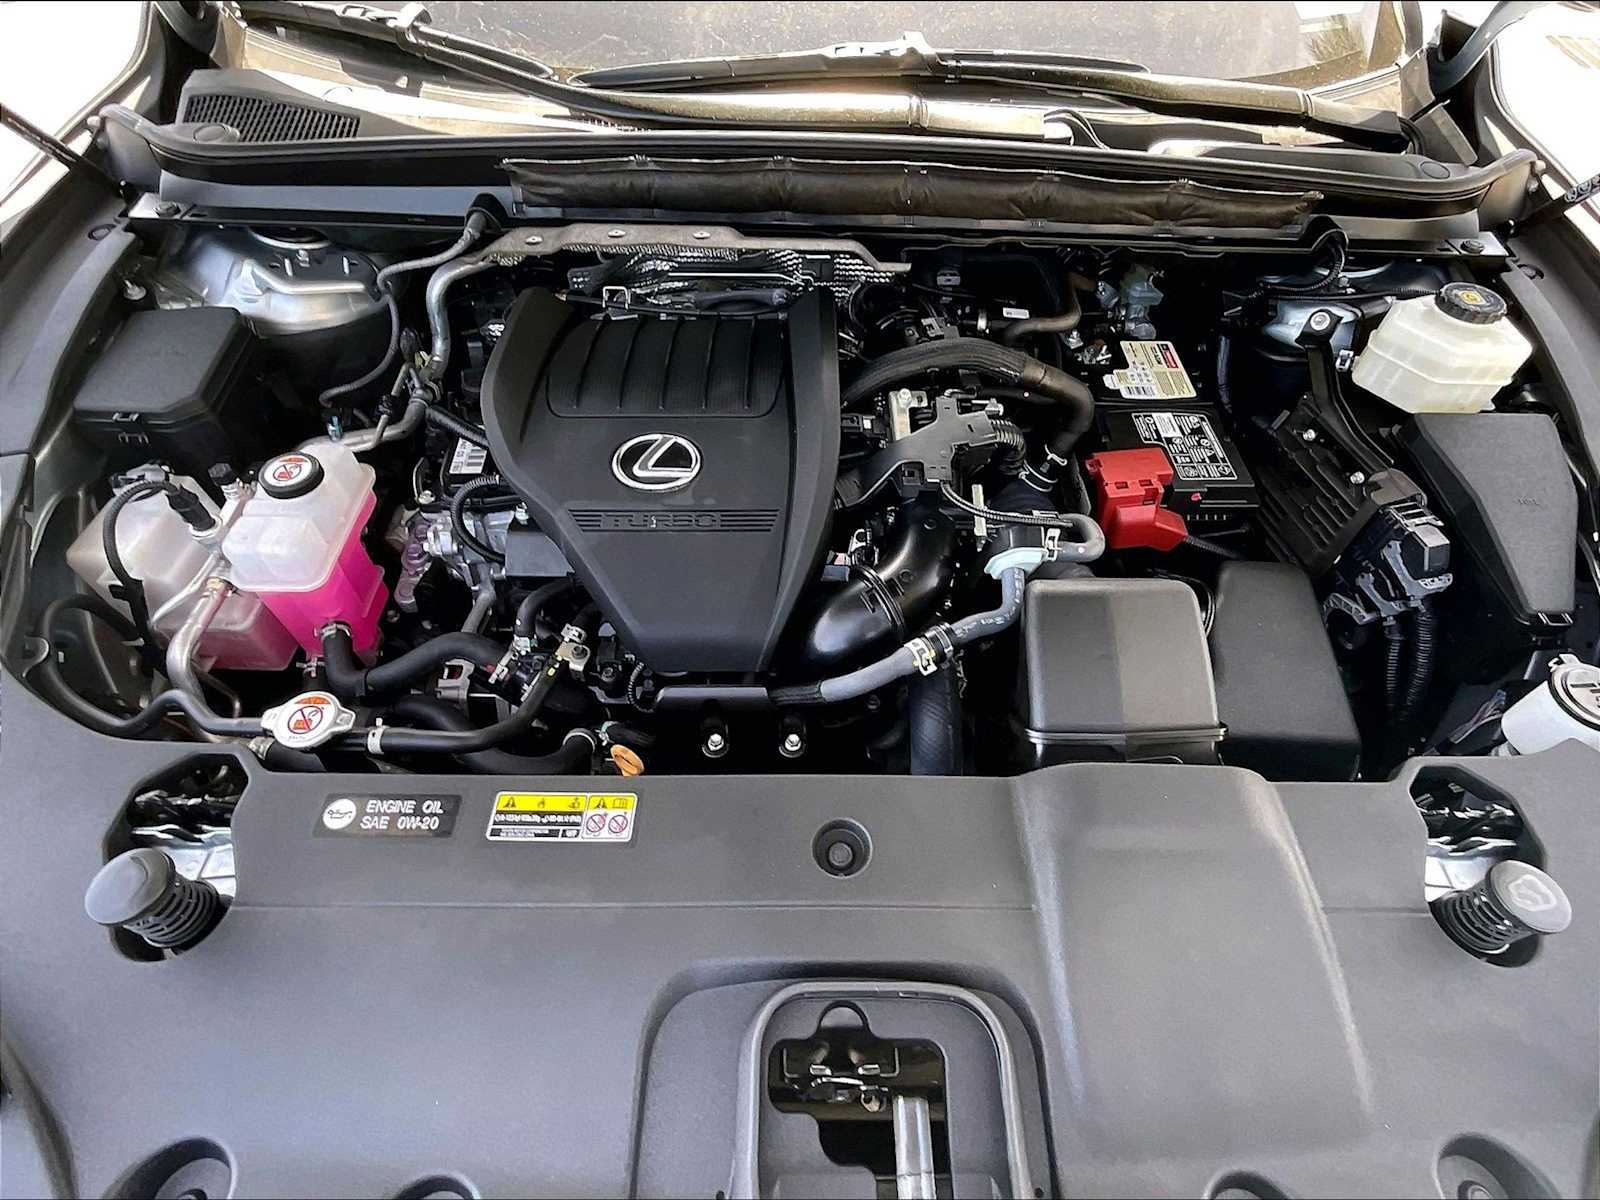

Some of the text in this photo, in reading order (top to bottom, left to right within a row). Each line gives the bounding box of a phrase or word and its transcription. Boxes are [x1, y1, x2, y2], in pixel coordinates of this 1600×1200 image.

[602, 513, 718, 529] TURBO
[365, 800, 445, 814] ENGINE OIL
[360, 816, 440, 830] SAE 0W-20
